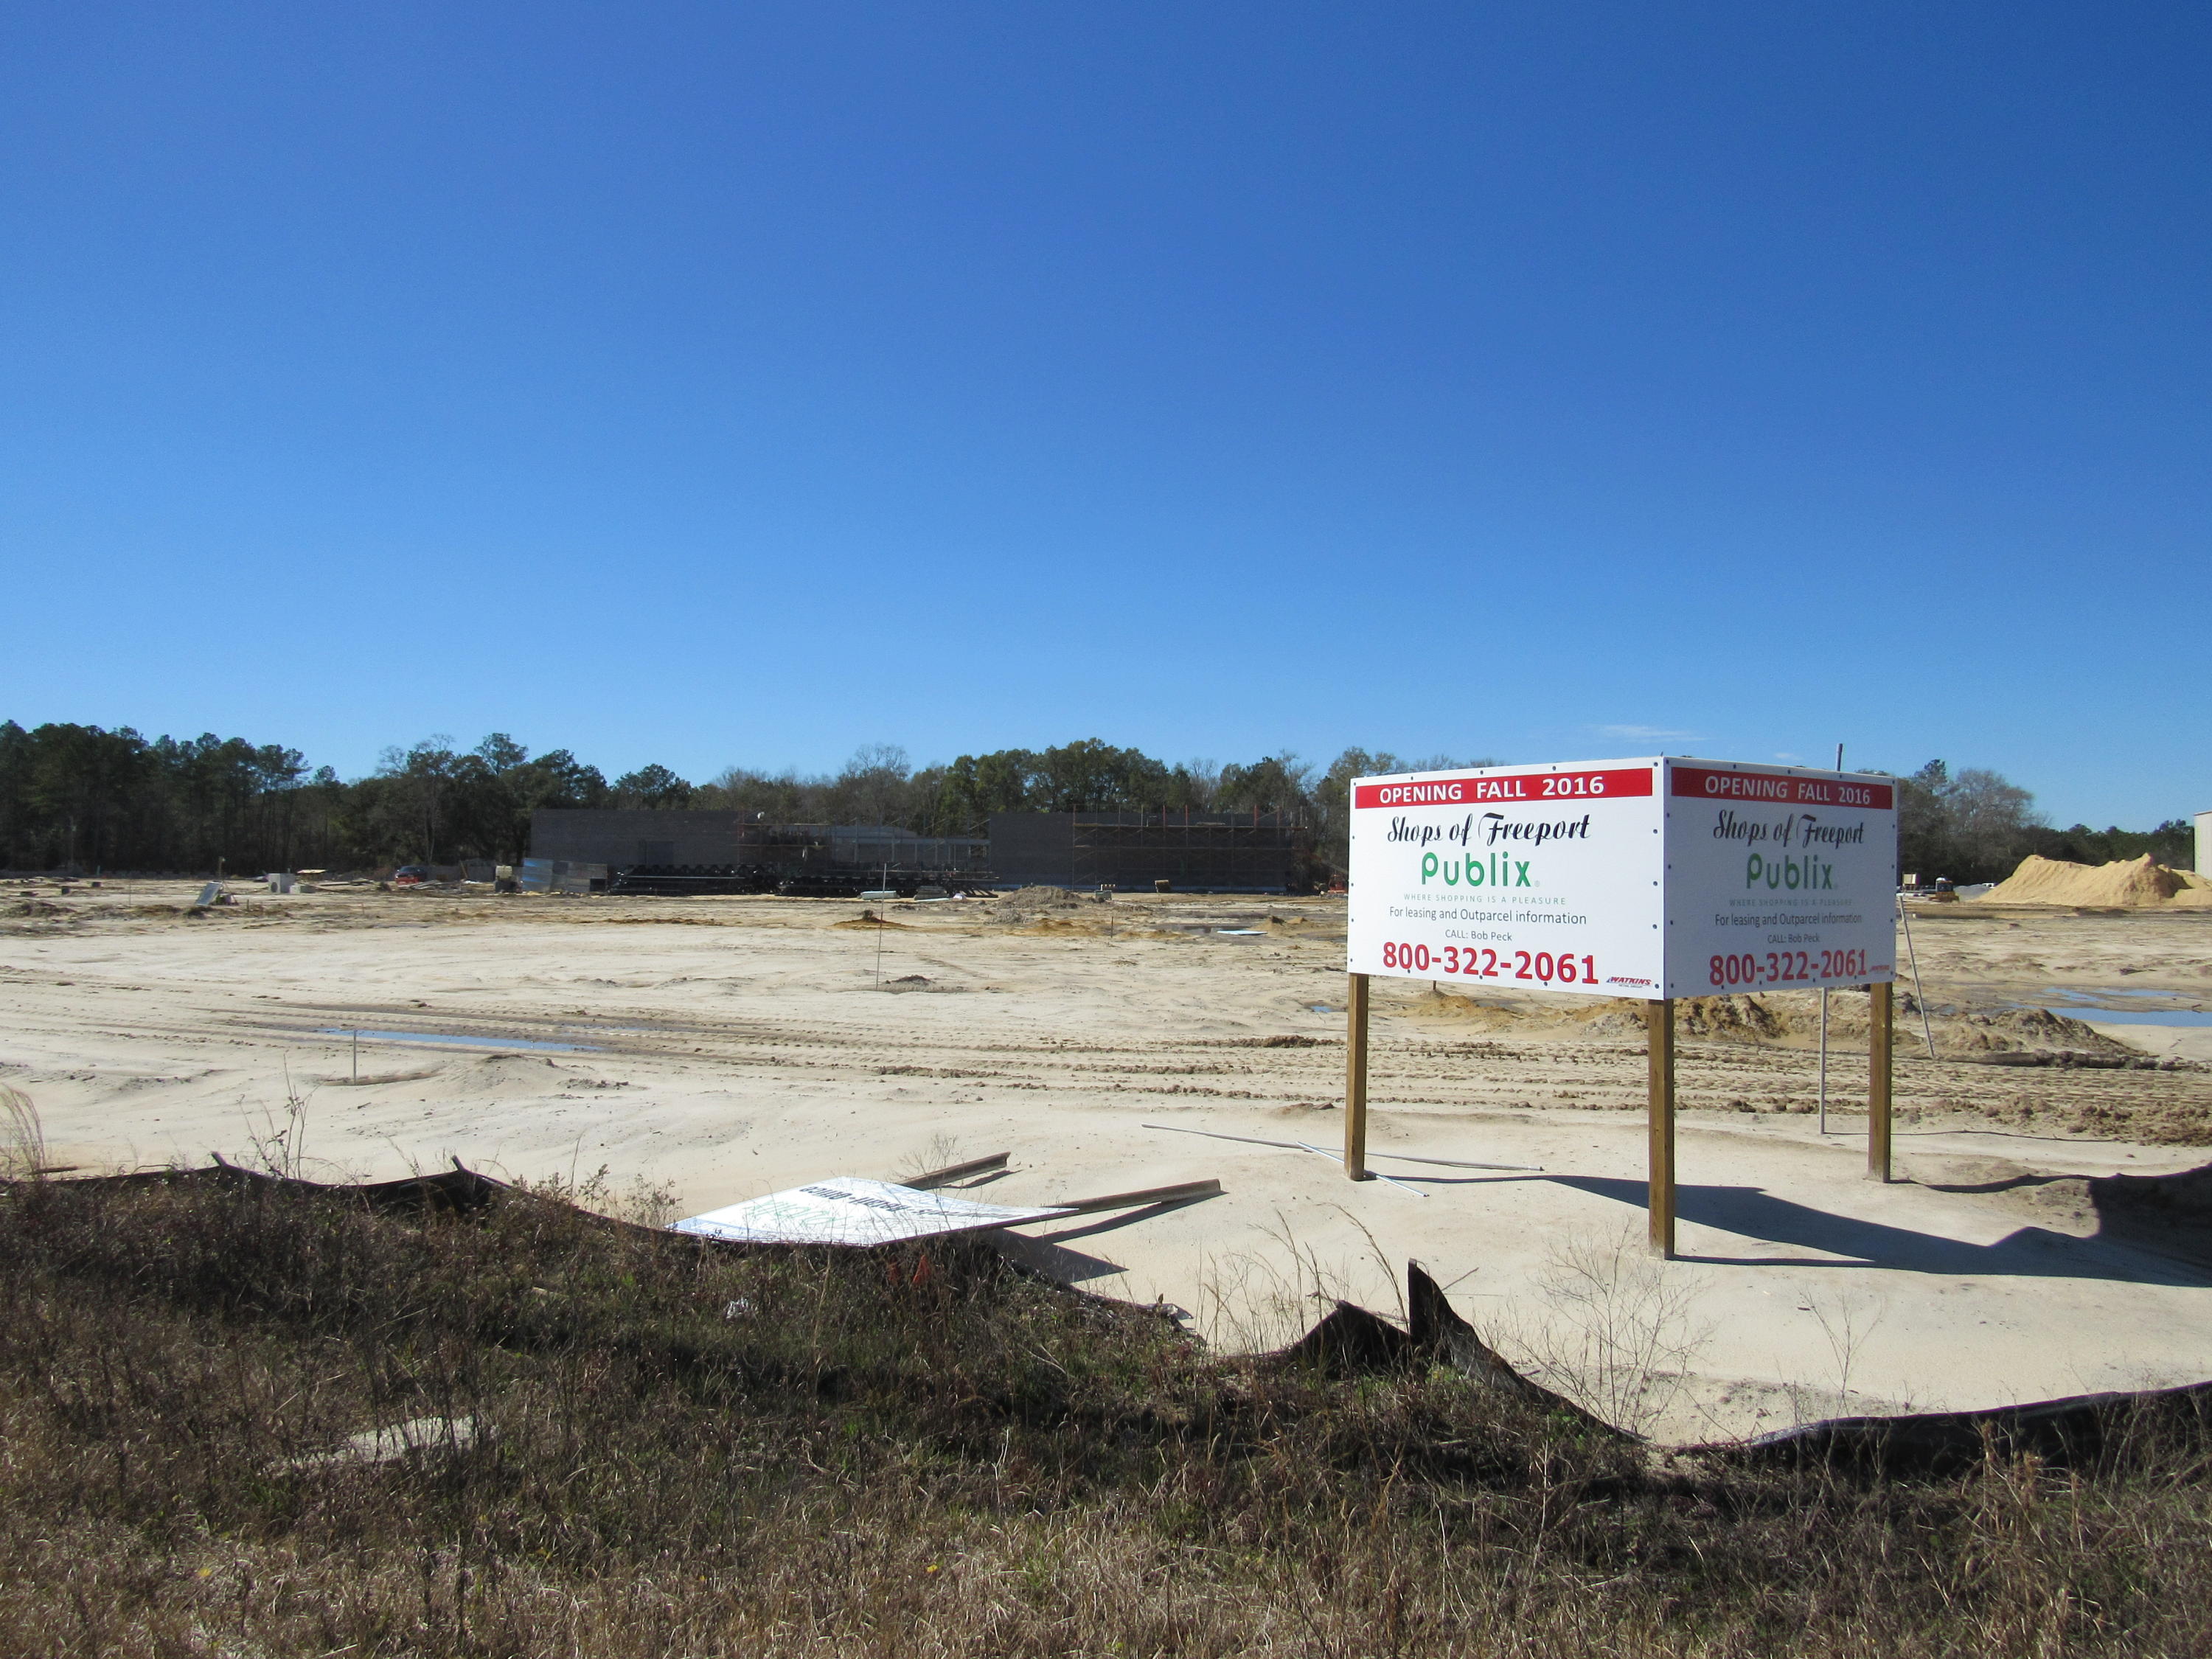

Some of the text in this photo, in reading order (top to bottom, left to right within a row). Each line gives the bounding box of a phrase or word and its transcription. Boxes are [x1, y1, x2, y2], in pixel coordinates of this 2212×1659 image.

[1379, 776, 1604, 804] OPENING FALL 2016
[1705, 776, 1871, 805] OPENING FALL 2016
[1387, 812, 1591, 847] Shops of Freeport
[1713, 810, 1864, 849] Shops of Freeport
[1422, 851, 1532, 887] Publix
[1746, 853, 1833, 889] Publix
[1436, 894, 1482, 902] SHOPPING
[1512, 897, 1566, 905] PLEASURE
[1729, 898, 1755, 906] WHERE
[1389, 906, 1587, 925] For leasing and Outparcel information
[1715, 912, 1862, 928] For leasing and Outparcel information
[1445, 929, 1512, 941] CALL: Bob Peck
[1767, 933, 1820, 944] CALL: Bob Peck
[1382, 942, 1599, 984] 800-322-2061
[1709, 949, 1867, 986] 800-322-2061
[1610, 976, 1652, 985] WATKINS
